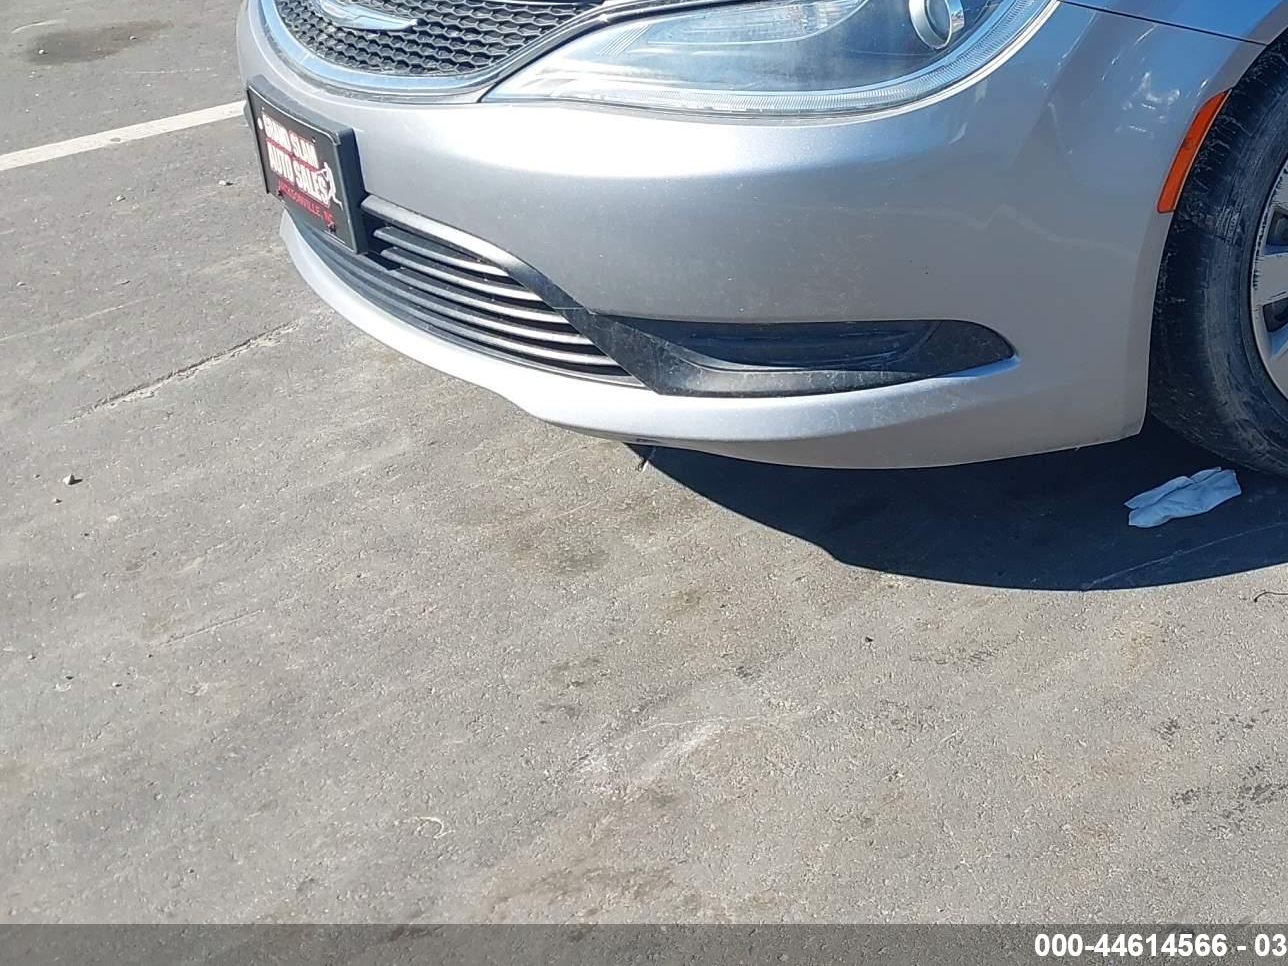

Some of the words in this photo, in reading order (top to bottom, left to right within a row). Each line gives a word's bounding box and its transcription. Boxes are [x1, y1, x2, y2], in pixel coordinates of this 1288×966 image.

[266, 140, 295, 186] AUTO
[292, 160, 330, 206] SALES
[288, 130, 320, 170] SLAM
